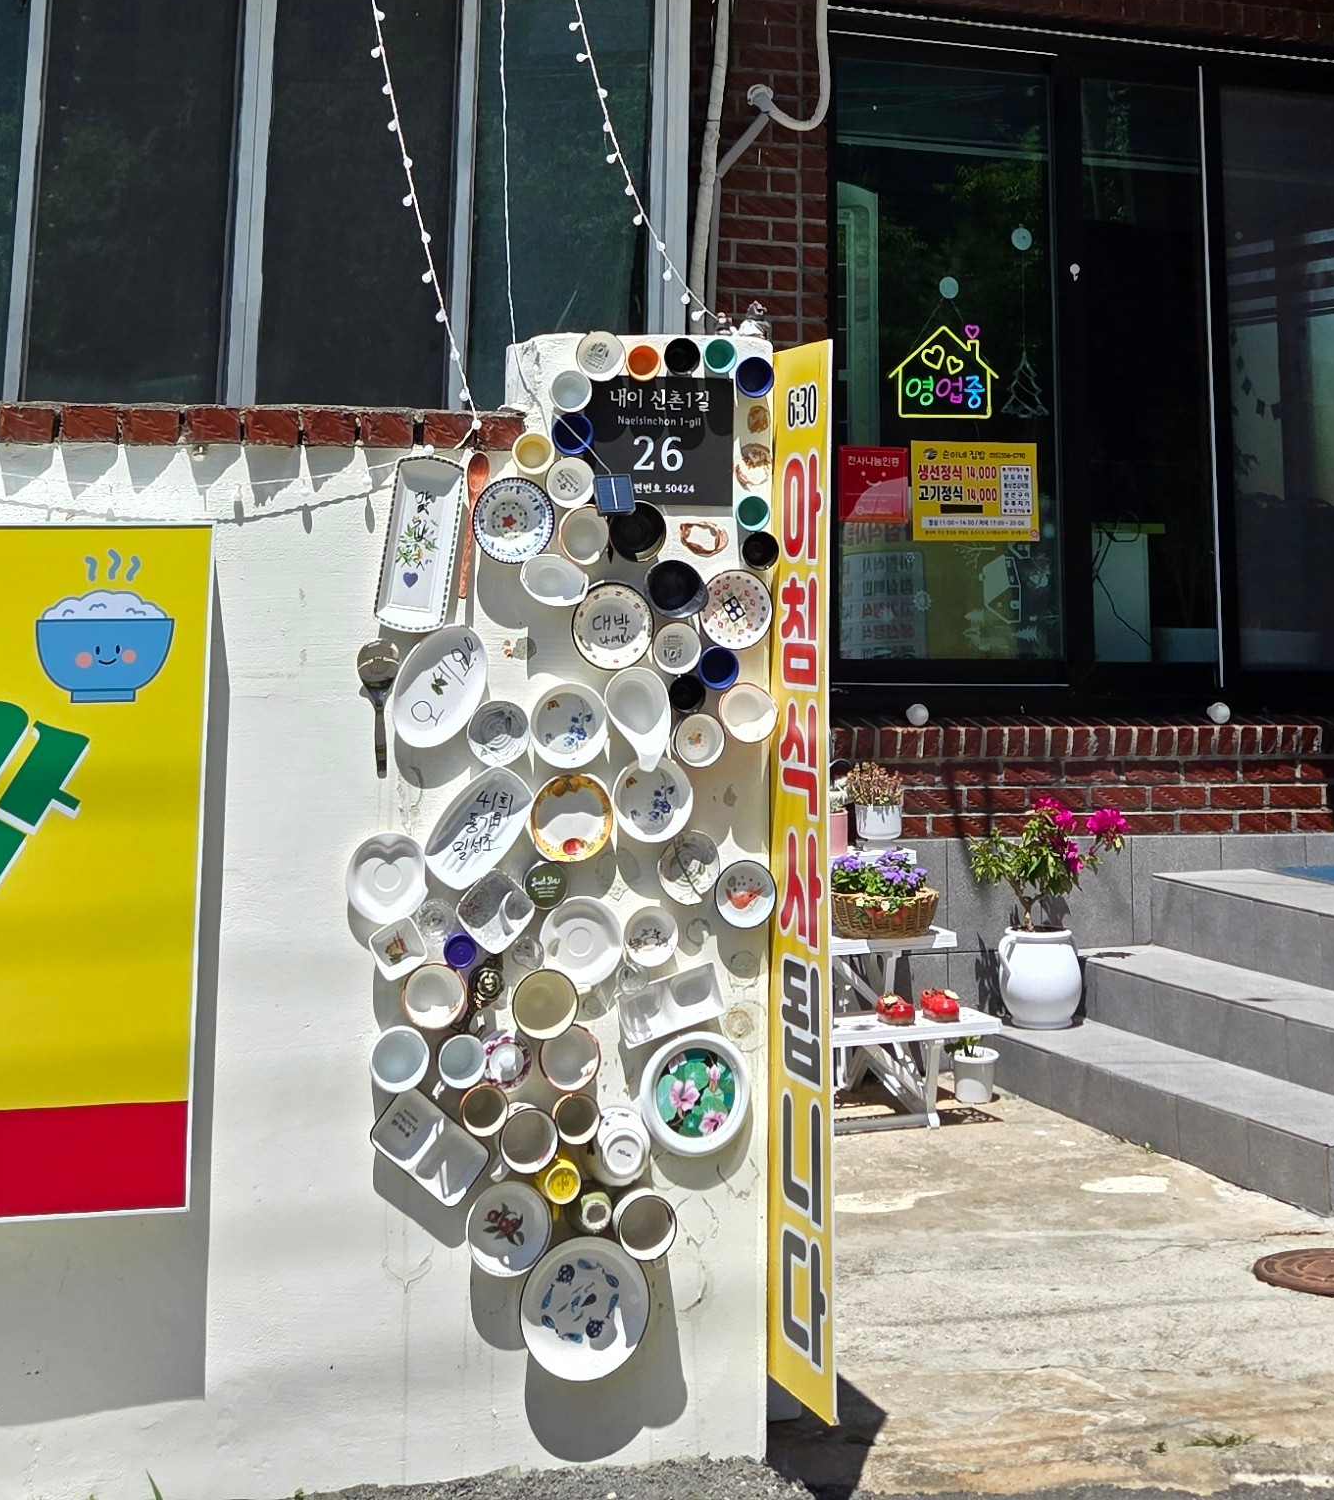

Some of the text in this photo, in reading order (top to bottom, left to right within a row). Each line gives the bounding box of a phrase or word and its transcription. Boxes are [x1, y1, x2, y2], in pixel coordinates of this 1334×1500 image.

[610, 388, 710, 412] 내이 신촌1길
[905, 375, 985, 409] 영업중
[787, 384, 817, 427] 6:30
[617, 415, 701, 428] Naeisinchon 1-gil
[633, 435, 684, 471] 26
[918, 464, 997, 481] 생선정식 14,000
[633, 482, 695, 494] 편번호 50424
[918, 485, 963, 501] 고기정식
[967, 488, 997, 503] 14,000
[592, 613, 630, 635] 대박
